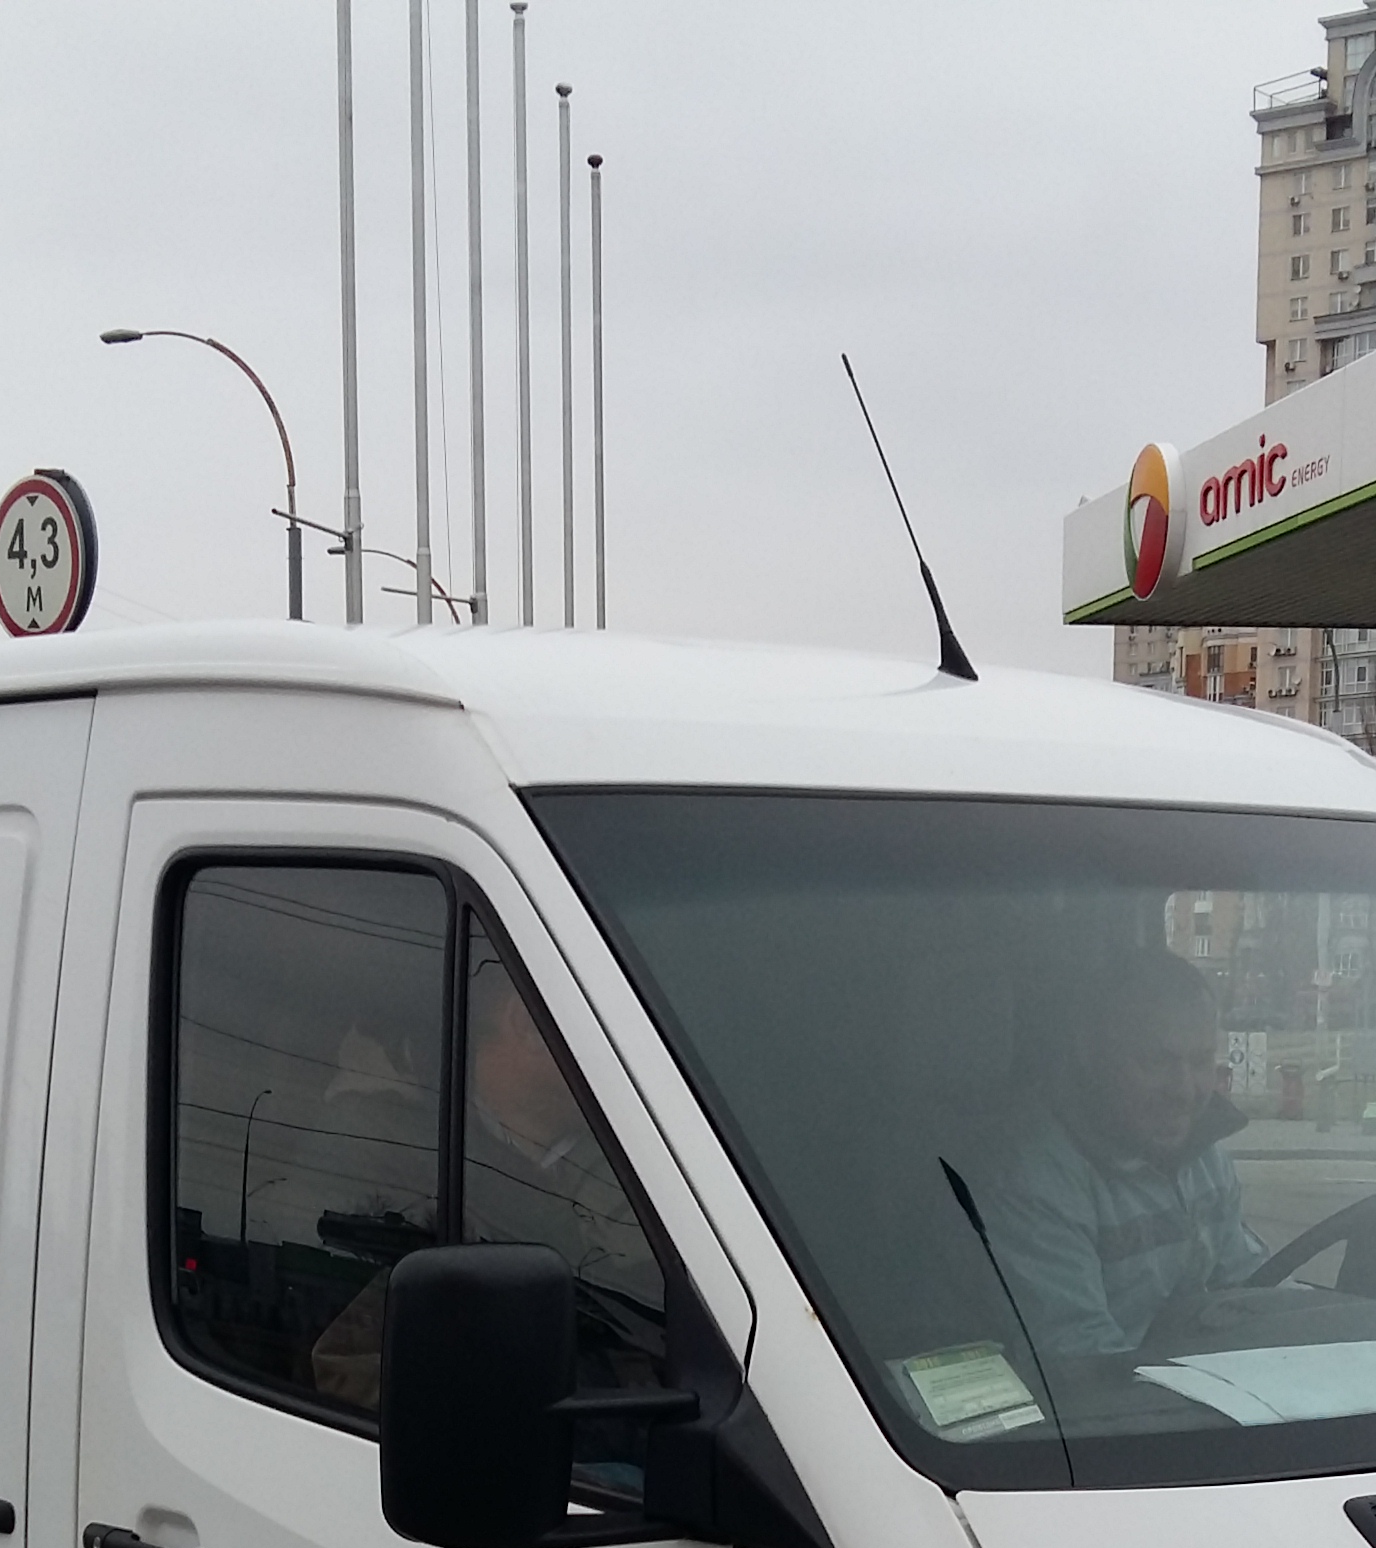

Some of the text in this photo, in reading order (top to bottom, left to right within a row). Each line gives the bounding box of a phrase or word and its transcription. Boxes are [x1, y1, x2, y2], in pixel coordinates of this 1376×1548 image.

[1199, 433, 1331, 527] amic ENERGY
[7, 516, 60, 580] 4,3
